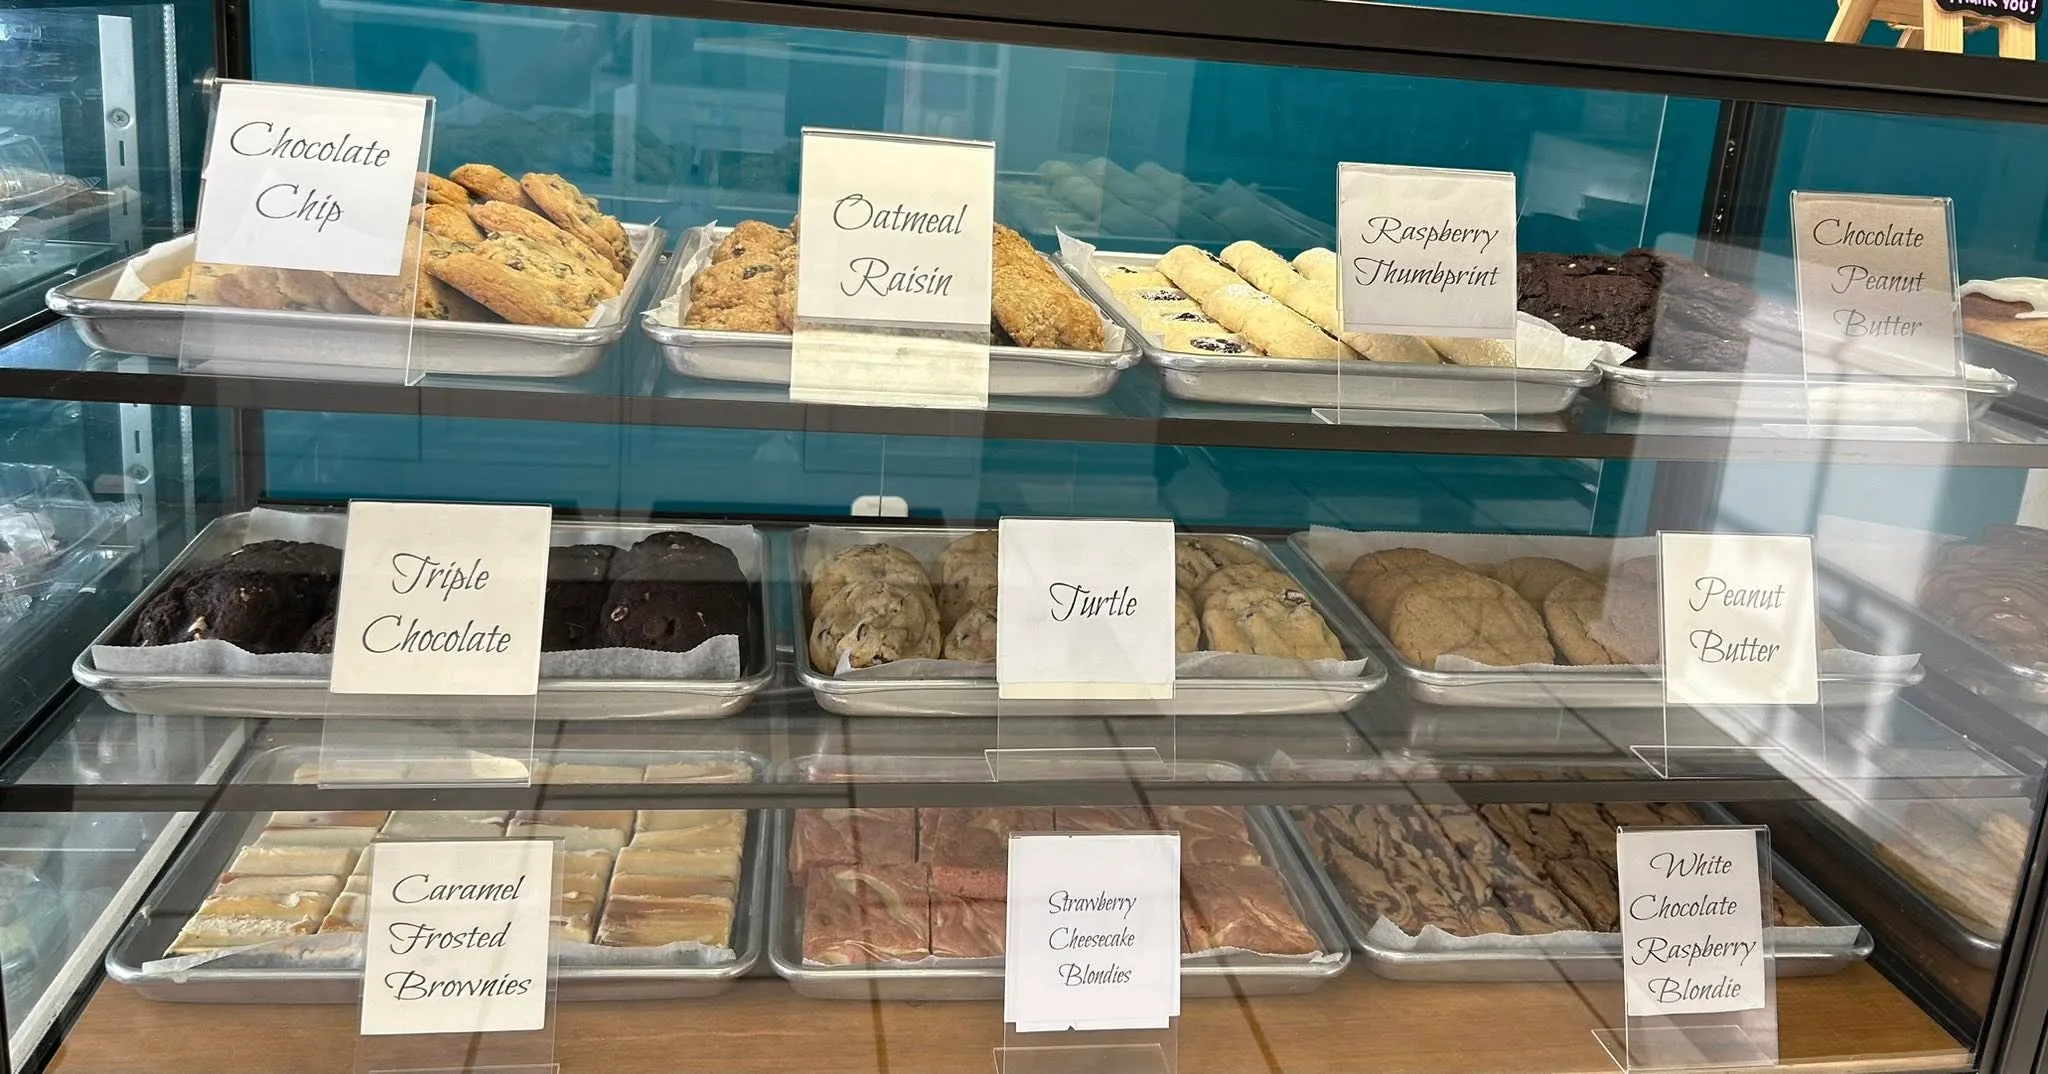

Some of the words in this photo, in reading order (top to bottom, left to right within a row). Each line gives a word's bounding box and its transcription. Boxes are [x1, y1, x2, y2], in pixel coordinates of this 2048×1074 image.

[230, 121, 391, 168] Chocolate
[256, 183, 344, 233] Chip
[833, 193, 968, 236] Oatmeal
[1361, 216, 1500, 254] Raspberry
[1813, 218, 1925, 248] Chocolate
[841, 256, 954, 298] Raisin
[1353, 257, 1501, 293] Thumbprint
[1831, 264, 1927, 294] Peanut
[1832, 308, 1923, 338] Butter
[392, 553, 490, 602] Triple
[1689, 576, 1786, 612] Peanut
[1049, 582, 1138, 622] Turtle
[362, 615, 512, 654] Chocolate
[1690, 629, 1781, 664] Butter
[1650, 852, 1733, 878] White
[392, 874, 526, 904] Caramel
[1049, 889, 1137, 920] Strawberry
[1629, 894, 1737, 921] Chocolate
[389, 921, 512, 956] Frosted
[1049, 925, 1136, 951] Cheesecake
[1631, 935, 1757, 967] Raspberry
[384, 970, 532, 1001] Brownies
[1059, 962, 1133, 987] Blondies
[1648, 976, 1742, 1004] Blondie
